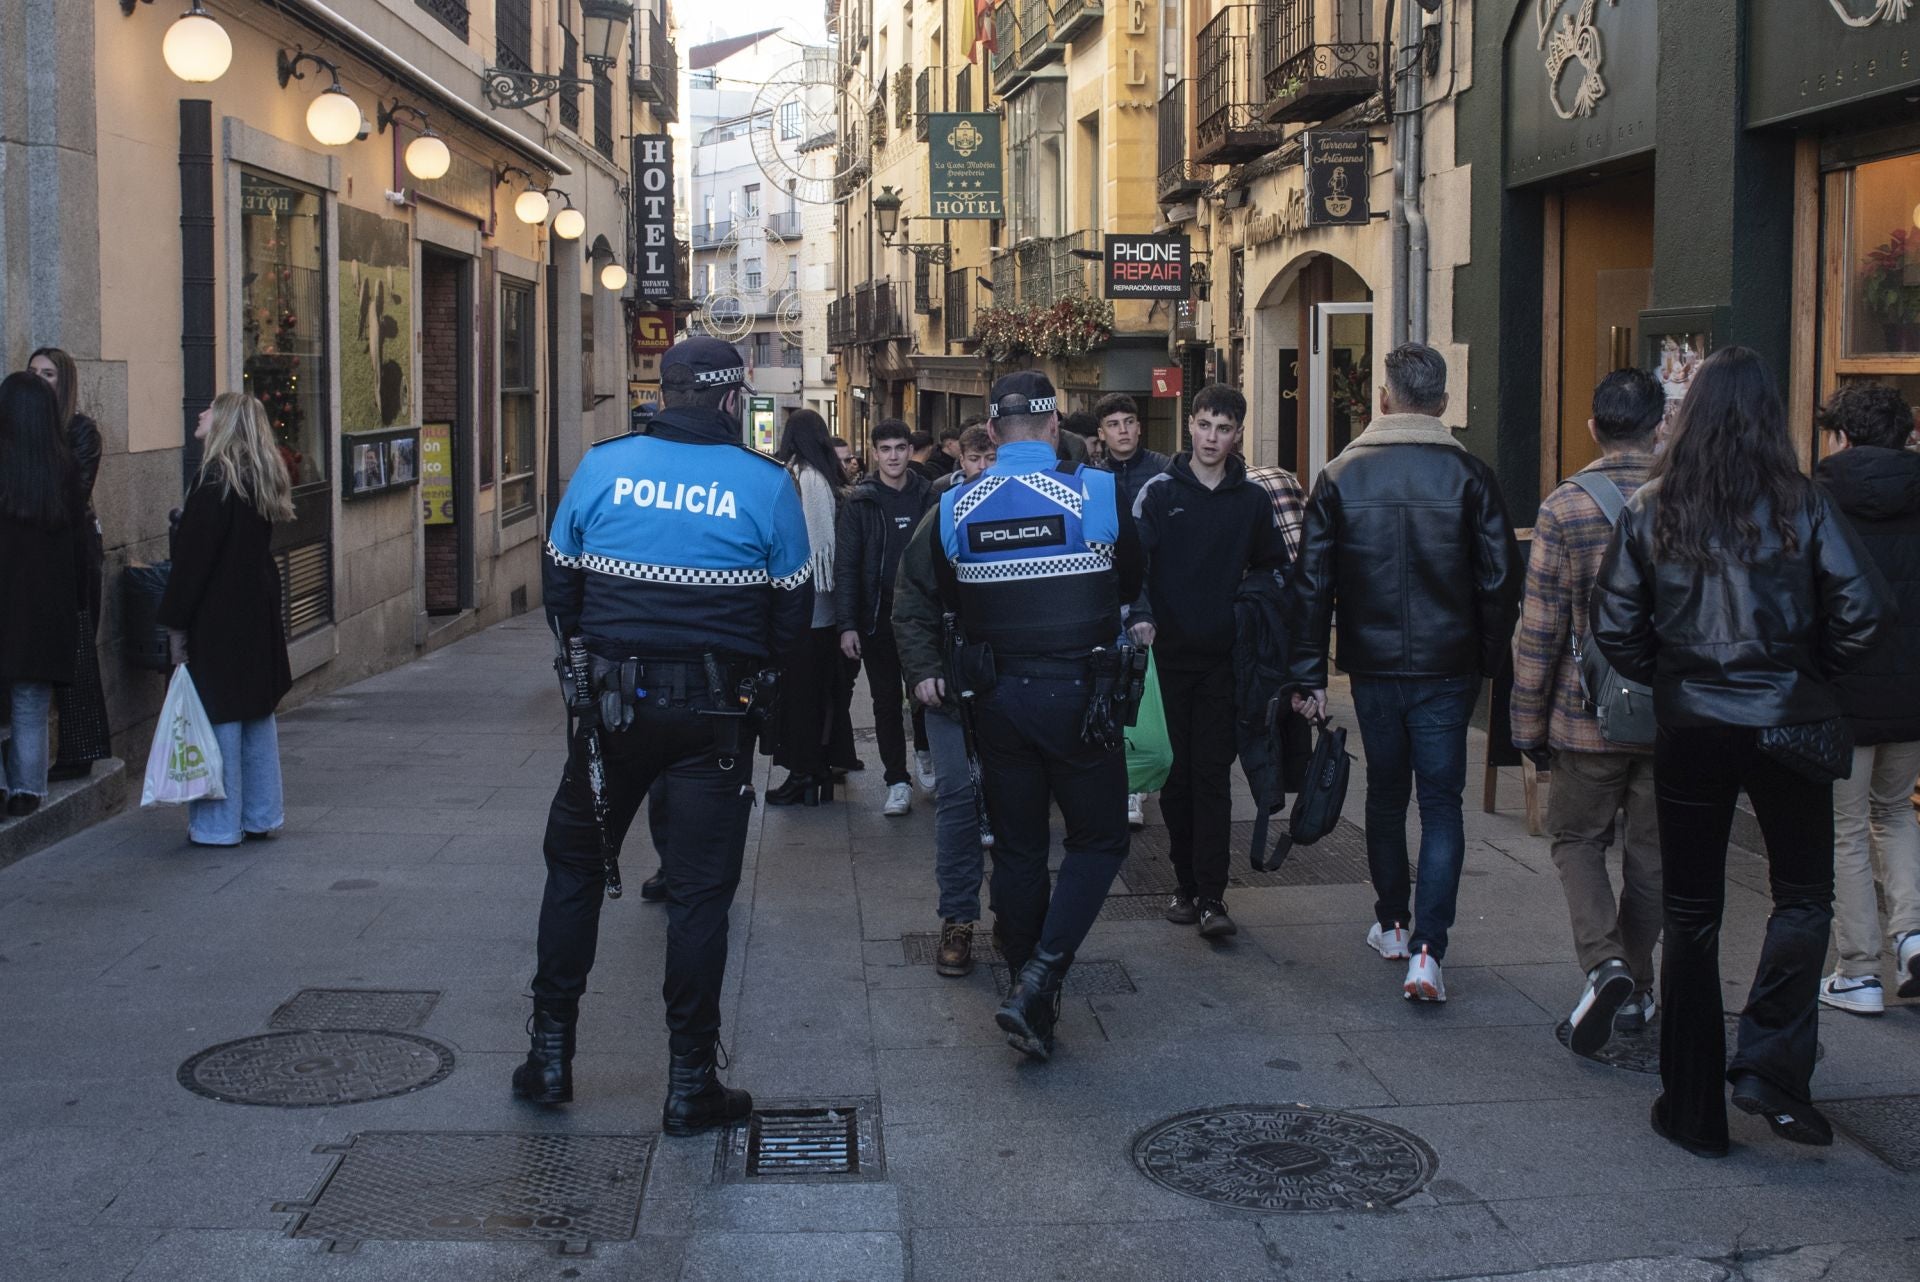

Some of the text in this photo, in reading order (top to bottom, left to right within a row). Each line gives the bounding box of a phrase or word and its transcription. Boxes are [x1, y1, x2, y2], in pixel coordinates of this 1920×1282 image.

[1318, 138, 1358, 150] Turrones
[1313, 152, 1364, 164] Artesanos
[642, 140, 666, 274] HOTEL
[936, 200, 1001, 214] HOTEL
[1113, 243, 1181, 261] PHONE
[1113, 262, 1181, 280] REPAIR
[631, 390, 658, 401] ATM
[613, 477, 737, 519] POLICÍA
[980, 524, 1052, 543] POLICIA
